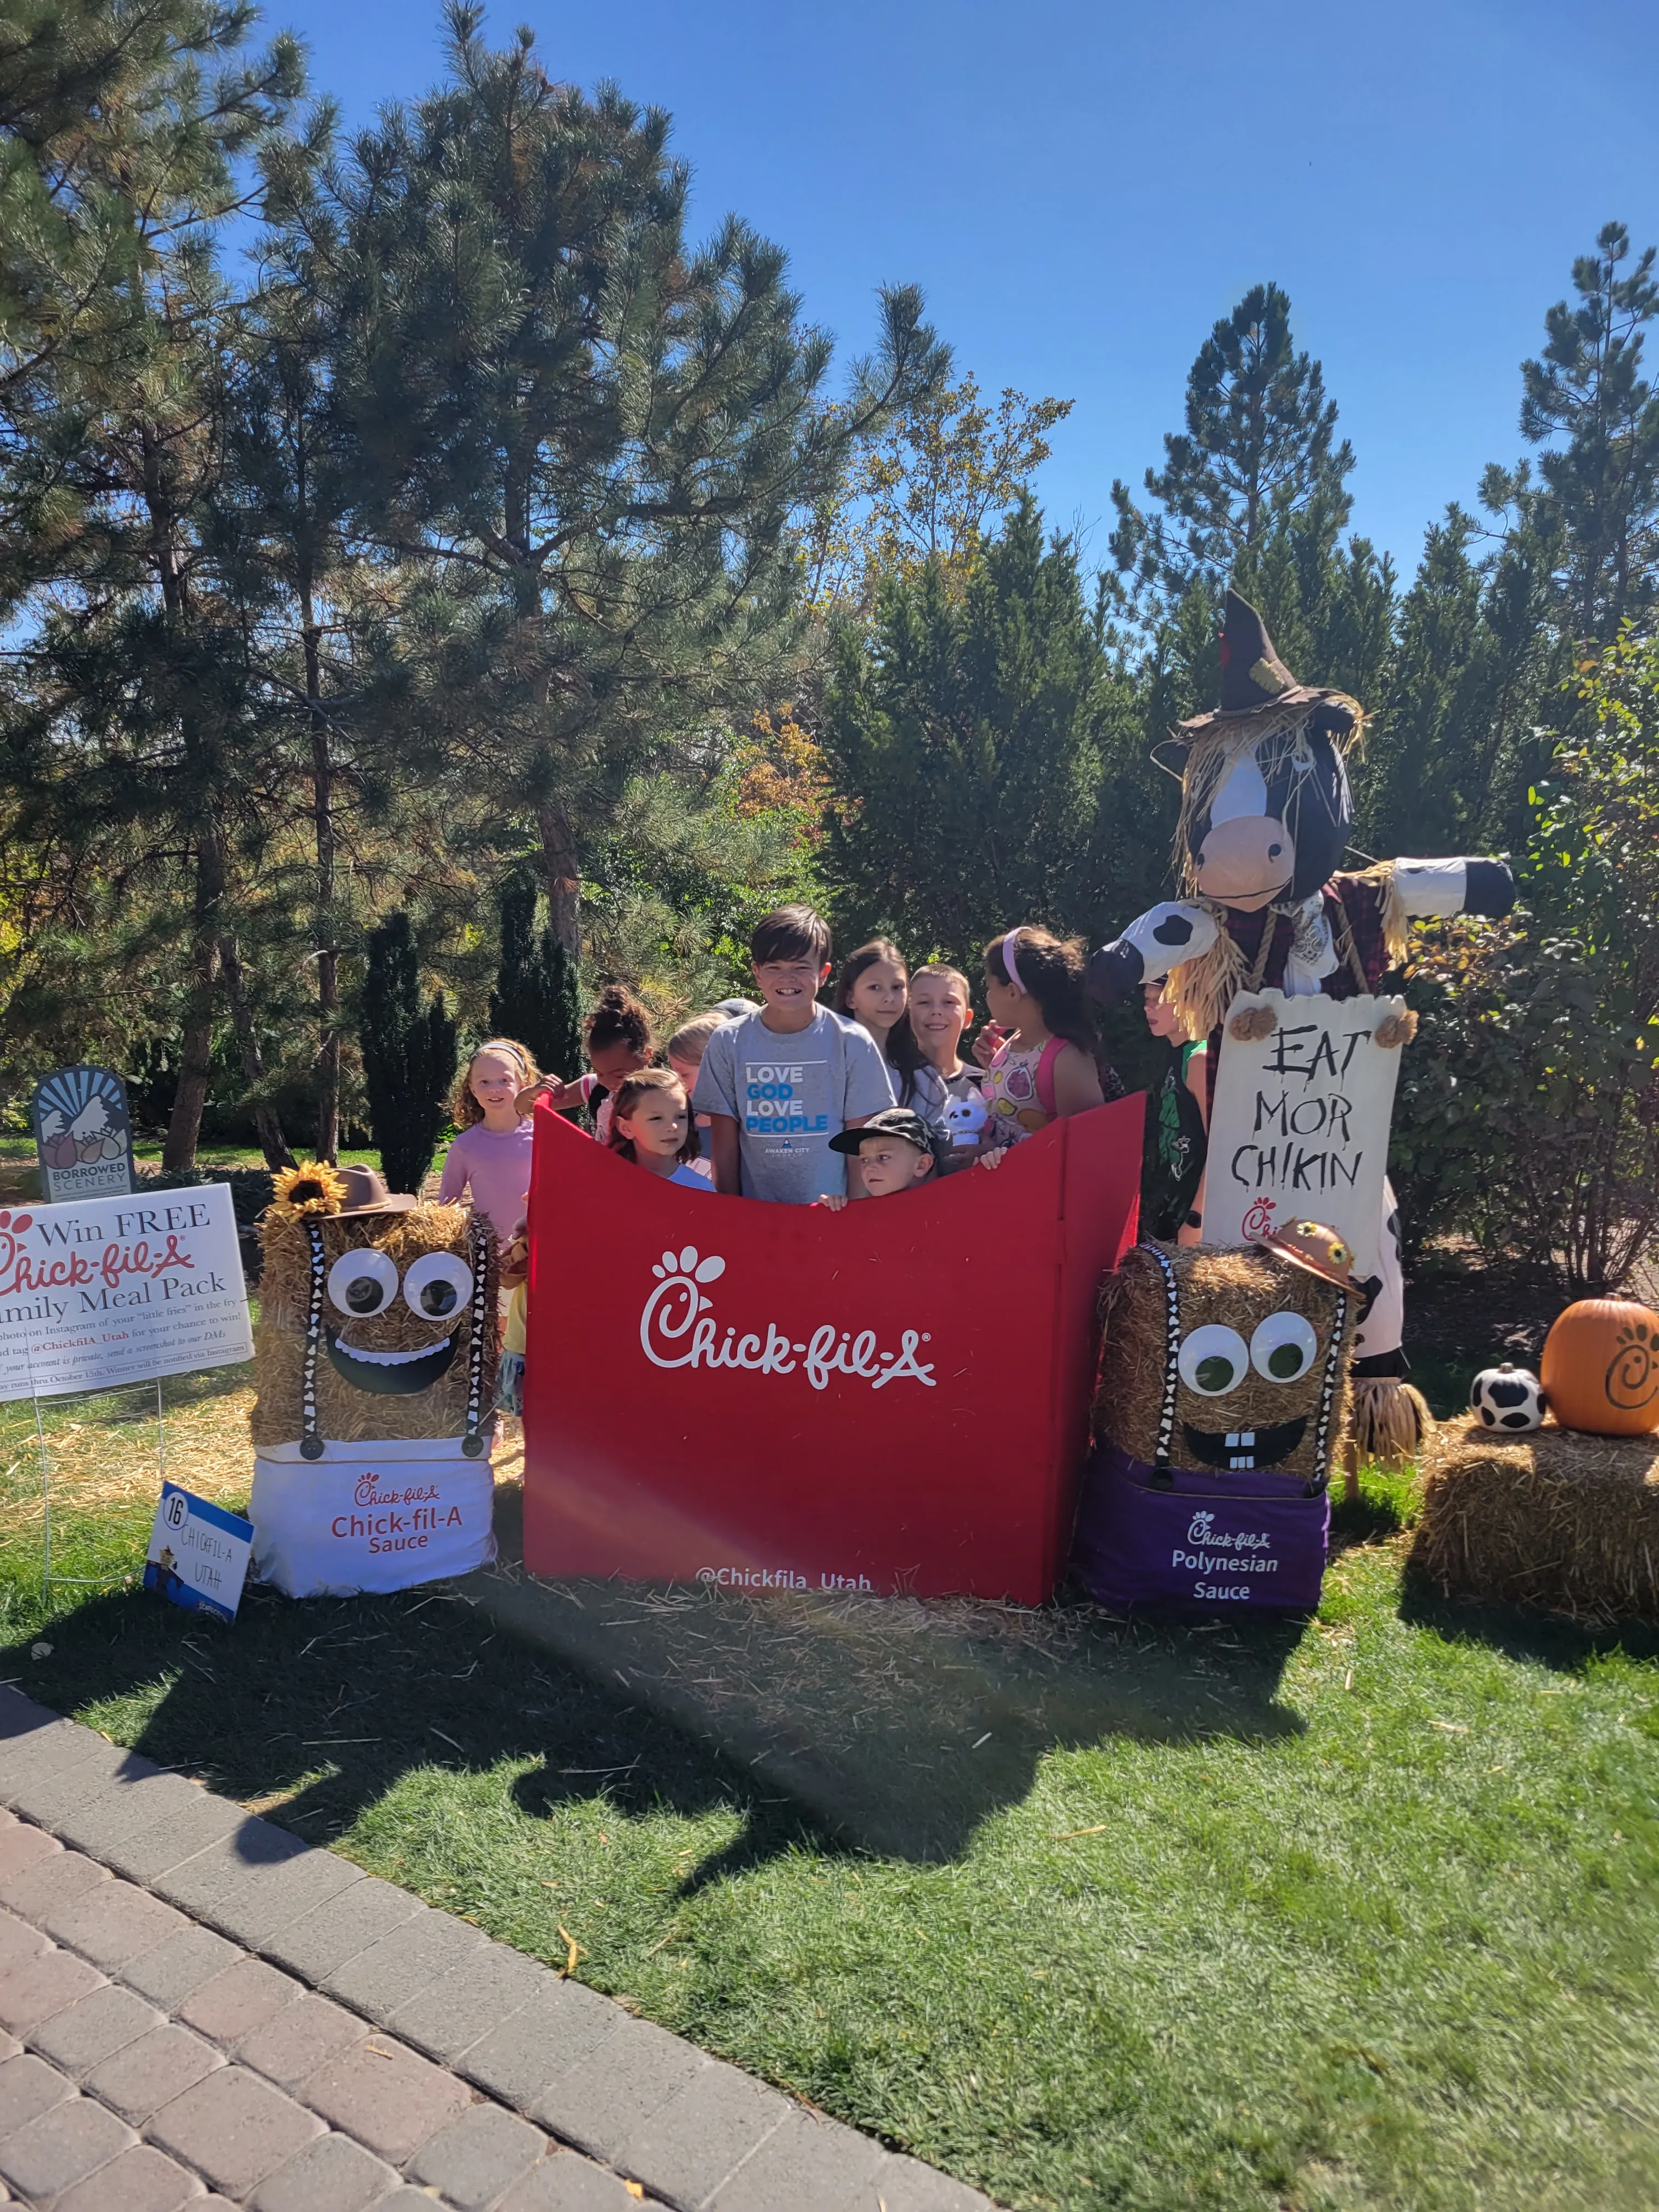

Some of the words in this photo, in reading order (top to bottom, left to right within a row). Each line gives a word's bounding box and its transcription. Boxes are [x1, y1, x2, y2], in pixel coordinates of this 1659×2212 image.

[1262, 1024, 1372, 1089] EAT
[746, 1066, 803, 1084] LOVE
[747, 1084, 793, 1100] GOD
[746, 1099, 803, 1116] LOVE
[1252, 1089, 1353, 1144] MOR
[746, 1115, 828, 1133] PEOPLE
[53, 1162, 126, 1181] BORROWED
[54, 1172, 126, 1192] SCENERY
[1232, 1142, 1363, 1194] CHIKIN
[35, 1219, 105, 1247] Win
[114, 1203, 211, 1238] FREE
[0, 1296, 69, 1324] mily
[77, 1282, 153, 1313] Meal
[160, 1272, 227, 1300] Pack
[46, 1322, 95, 1335] Instagram
[99, 1318, 110, 1327] of
[112, 1316, 134, 1327] your
[206, 1301, 222, 1310] the
[224, 1298, 238, 1307] fry
[13, 1347, 29, 1357] tag
[132, 1329, 146, 1338] for
[149, 1325, 171, 1337] your
[173, 1319, 207, 1330] chance
[221, 1312, 241, 1322] win!
[640, 1274, 937, 1390] Chick-fil-A
[3, 1363, 25, 1375] your
[27, 1358, 60, 1369] account
[63, 1356, 71, 1365] is
[72, 1352, 103, 1366] private,
[106, 1347, 125, 1358] send
[135, 1338, 176, 1353] screenshot
[188, 1335, 202, 1344] our
[204, 1329, 227, 1341] DMs
[11, 1380, 29, 1389] runs
[50, 1373, 83, 1383] October
[106, 1363, 136, 1375] Winner
[137, 1360, 150, 1369] will
[164, 1353, 193, 1364] notified
[194, 1351, 205, 1359] via
[207, 1345, 245, 1357] Instagram
[354, 1479, 441, 1507] Chick-fil-A
[168, 1497, 184, 1526] 16
[331, 1506, 463, 1538] Chick-fil-A
[368, 1535, 428, 1554] Sauce
[1187, 1517, 1272, 1551] Chick-fil-A
[195, 1562, 222, 1590] UTAH
[1171, 1549, 1278, 1575] Polynesian
[1193, 1581, 1251, 1600] Sauce
